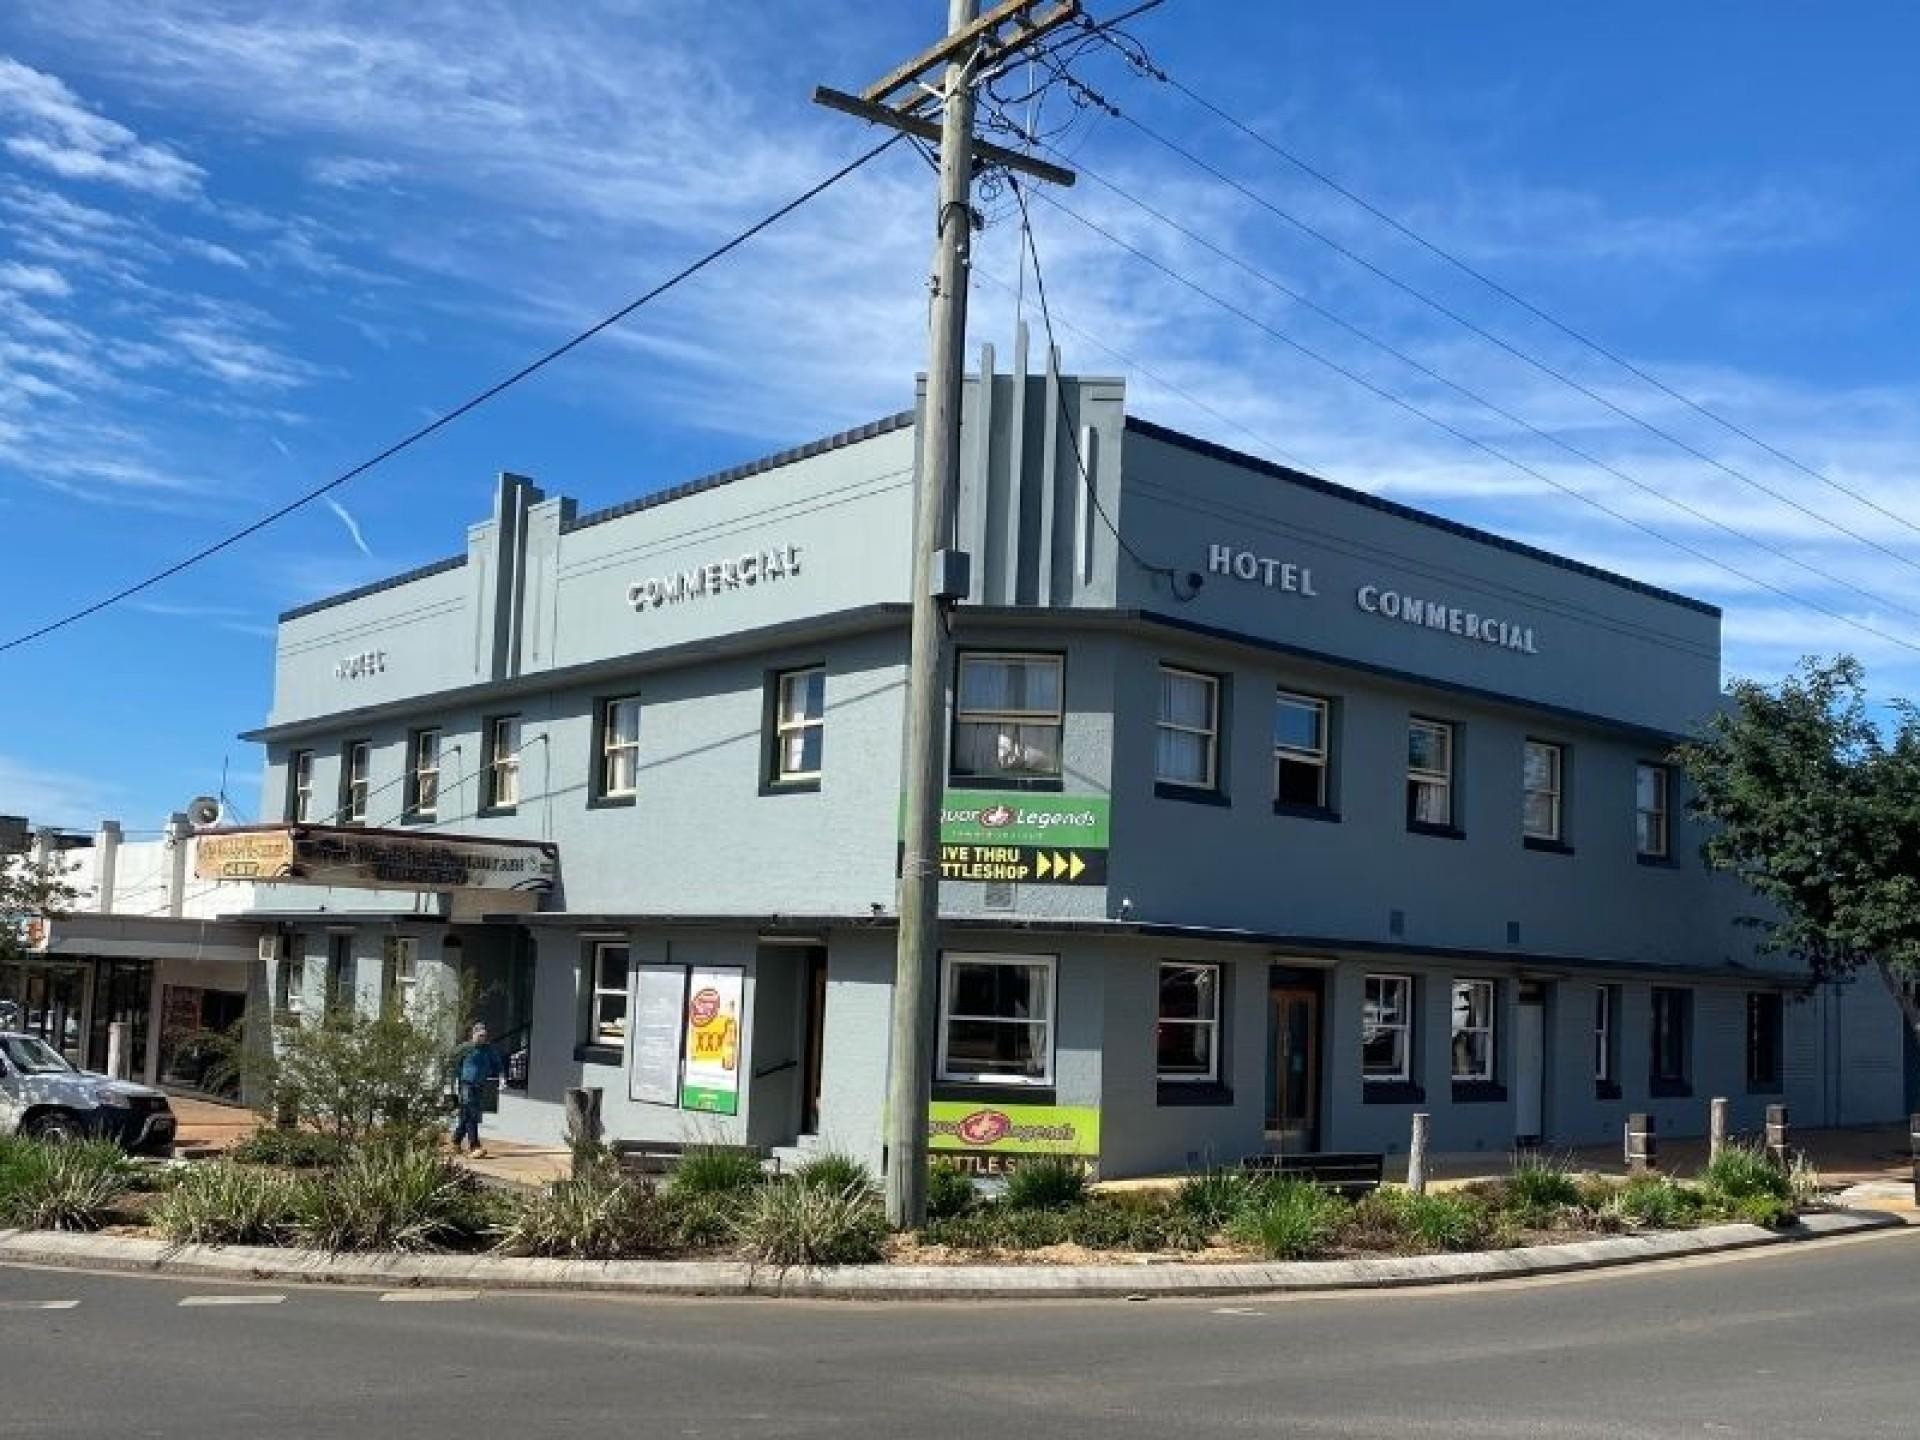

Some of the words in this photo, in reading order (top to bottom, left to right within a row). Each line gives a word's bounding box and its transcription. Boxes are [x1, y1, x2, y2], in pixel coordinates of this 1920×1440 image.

[628, 544, 801, 612] COMMERCIAL
[1208, 544, 1318, 596] HOTEL
[1357, 585, 1537, 655] COMMERCIAL
[1017, 808, 1095, 829] Legends
[942, 846, 968, 861] IVE
[974, 847, 1020, 863] THRU
[940, 863, 1029, 880] TTLESHOP
[696, 1032, 724, 1052] XXX
